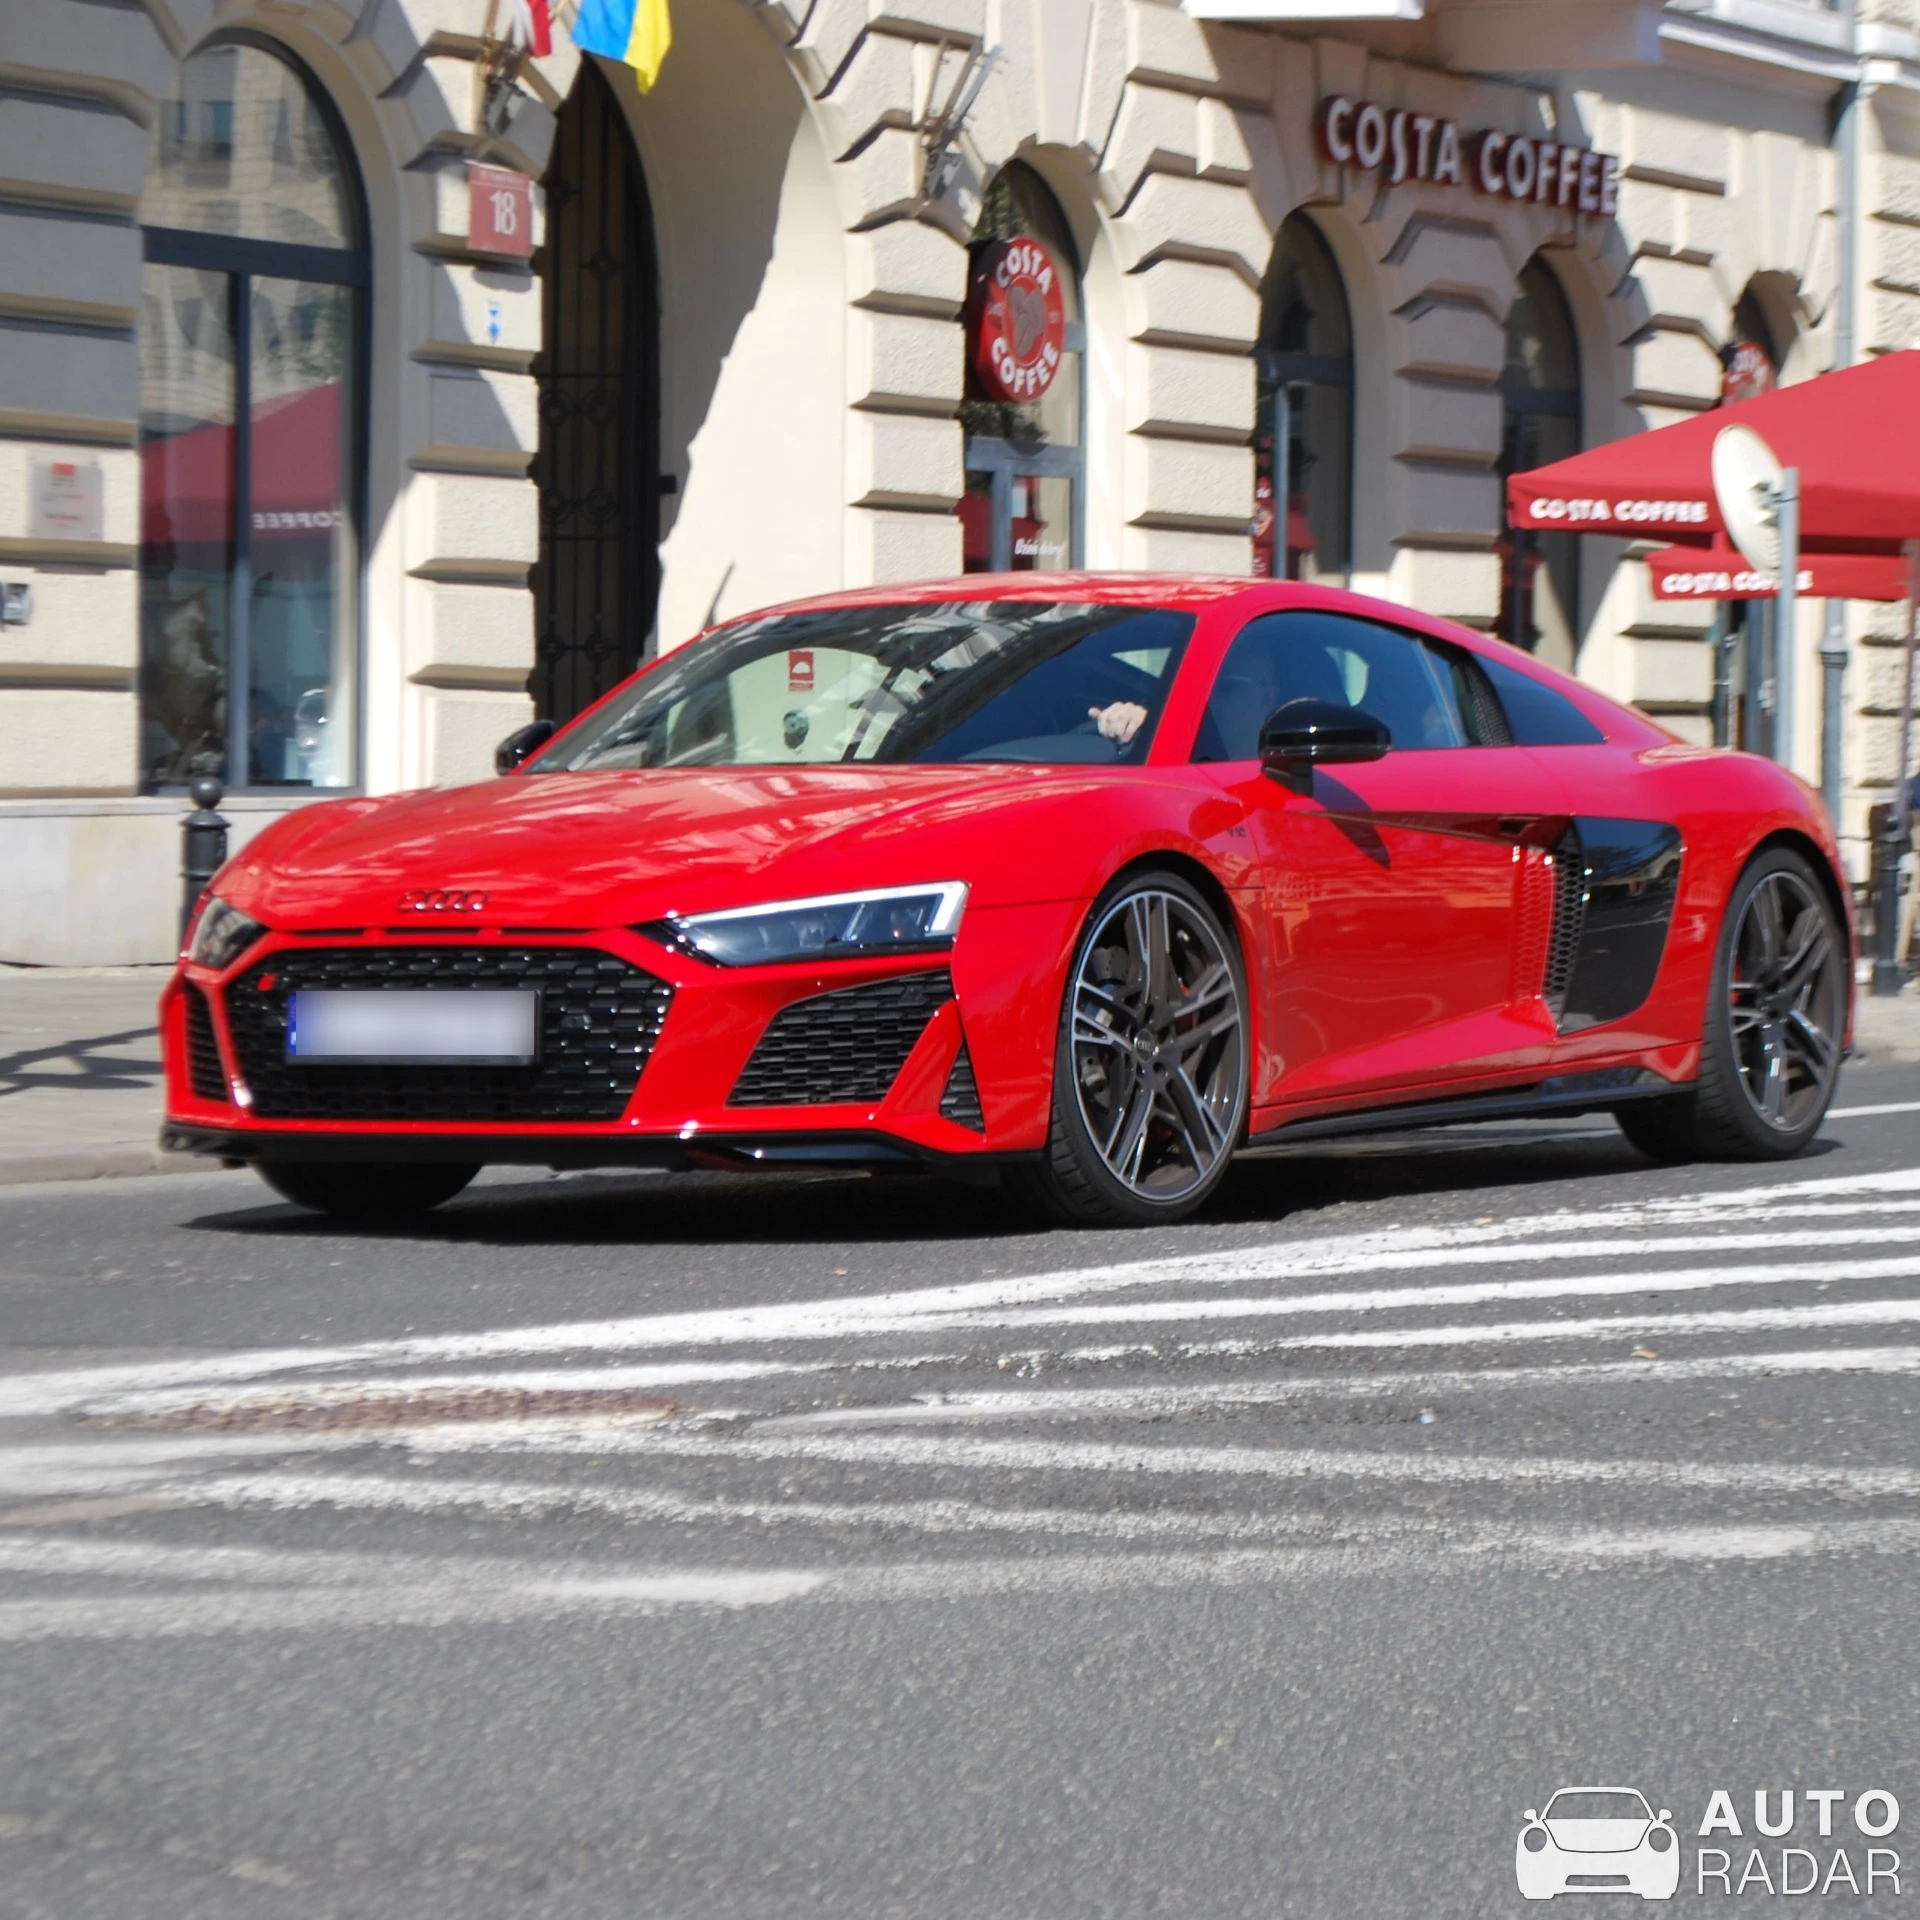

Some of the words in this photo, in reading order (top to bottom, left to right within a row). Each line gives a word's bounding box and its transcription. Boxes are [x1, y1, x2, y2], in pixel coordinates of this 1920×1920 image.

[1326, 98, 1461, 184] COSTA
[1480, 130, 1618, 214] COFFEE
[489, 190, 517, 235] 18
[996, 244, 1053, 295] COSTA
[991, 337, 1059, 396] COFFEE
[1529, 498, 1611, 521] COSTA
[1613, 500, 1709, 522] COFFEE
[1661, 571, 1731, 594] COSTA
